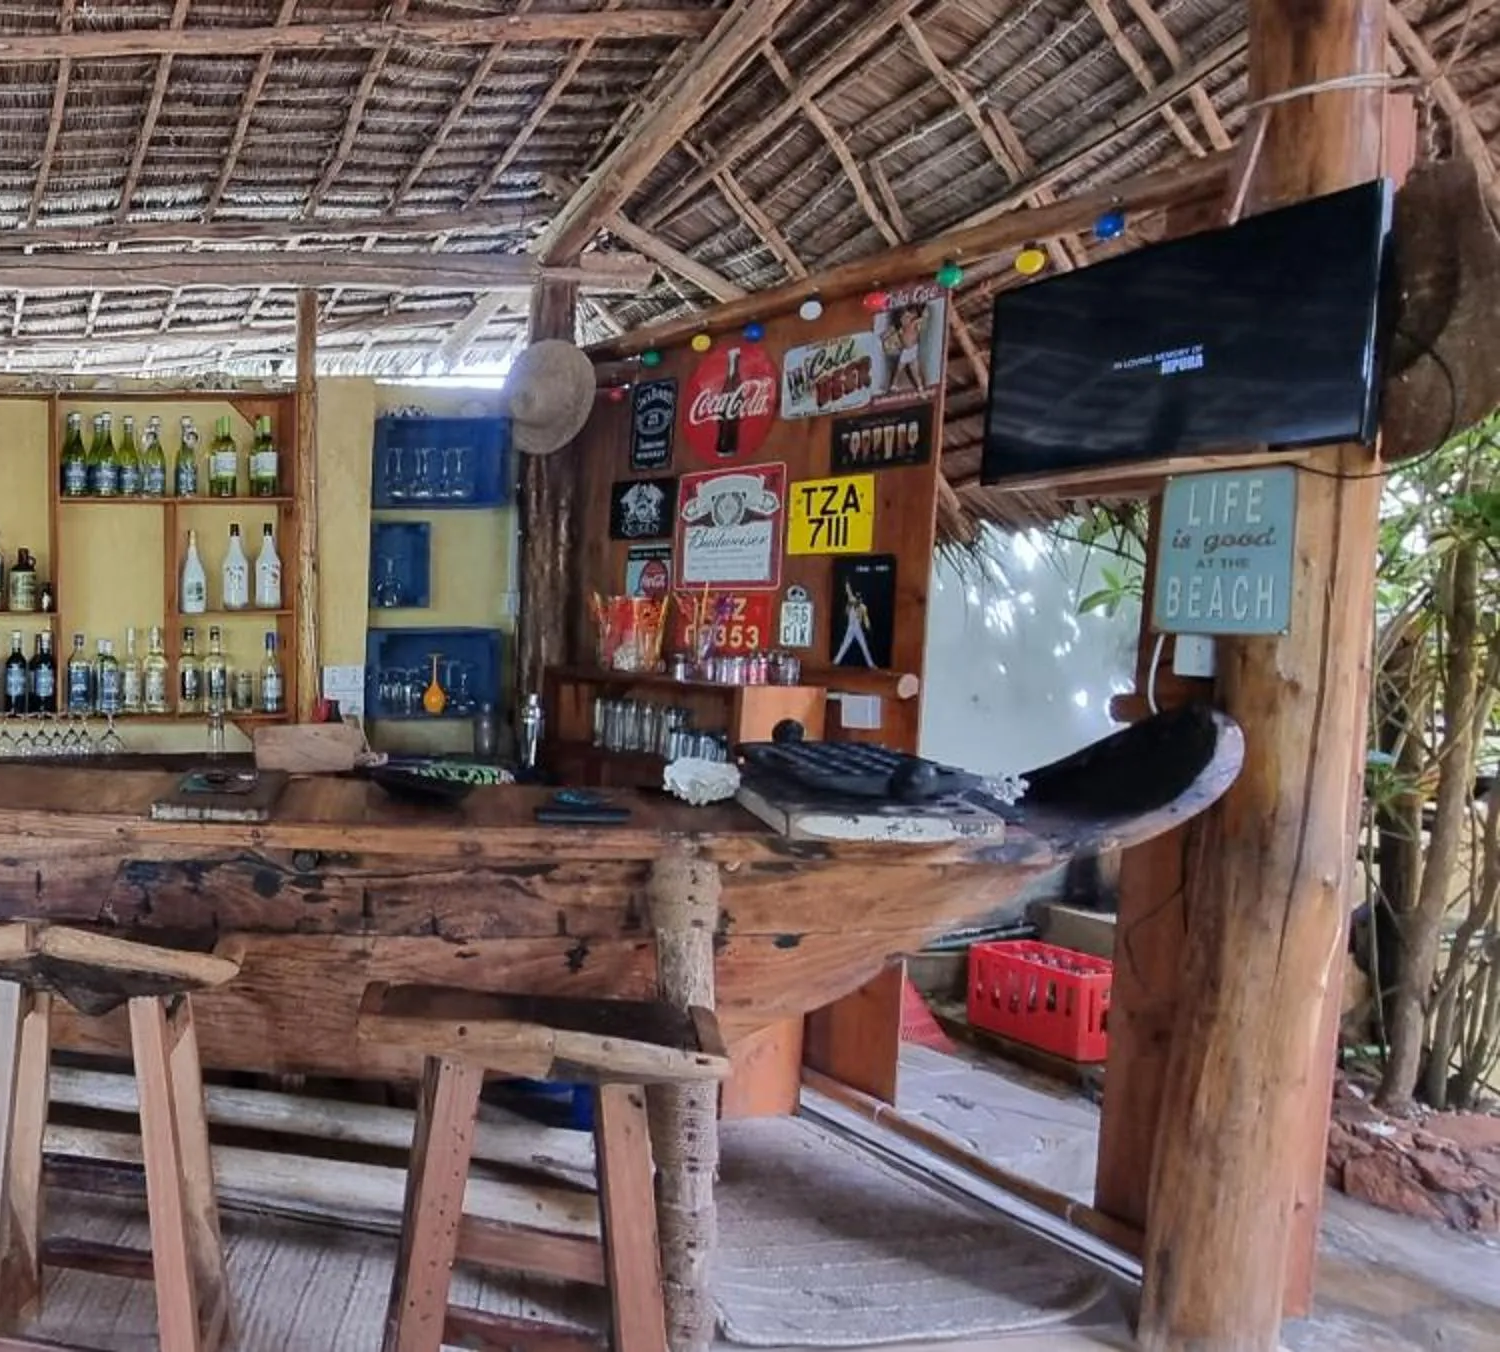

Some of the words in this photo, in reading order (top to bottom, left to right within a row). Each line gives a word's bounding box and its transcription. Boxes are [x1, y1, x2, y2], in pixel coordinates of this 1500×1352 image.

[801, 483, 861, 517] TZA
[1187, 479, 1264, 526] LIFE
[1171, 528, 1192, 549] is
[1203, 526, 1276, 555] good
[1196, 558, 1213, 569] AT
[1219, 557, 1250, 570] THE
[1166, 575, 1275, 621] BEACH
